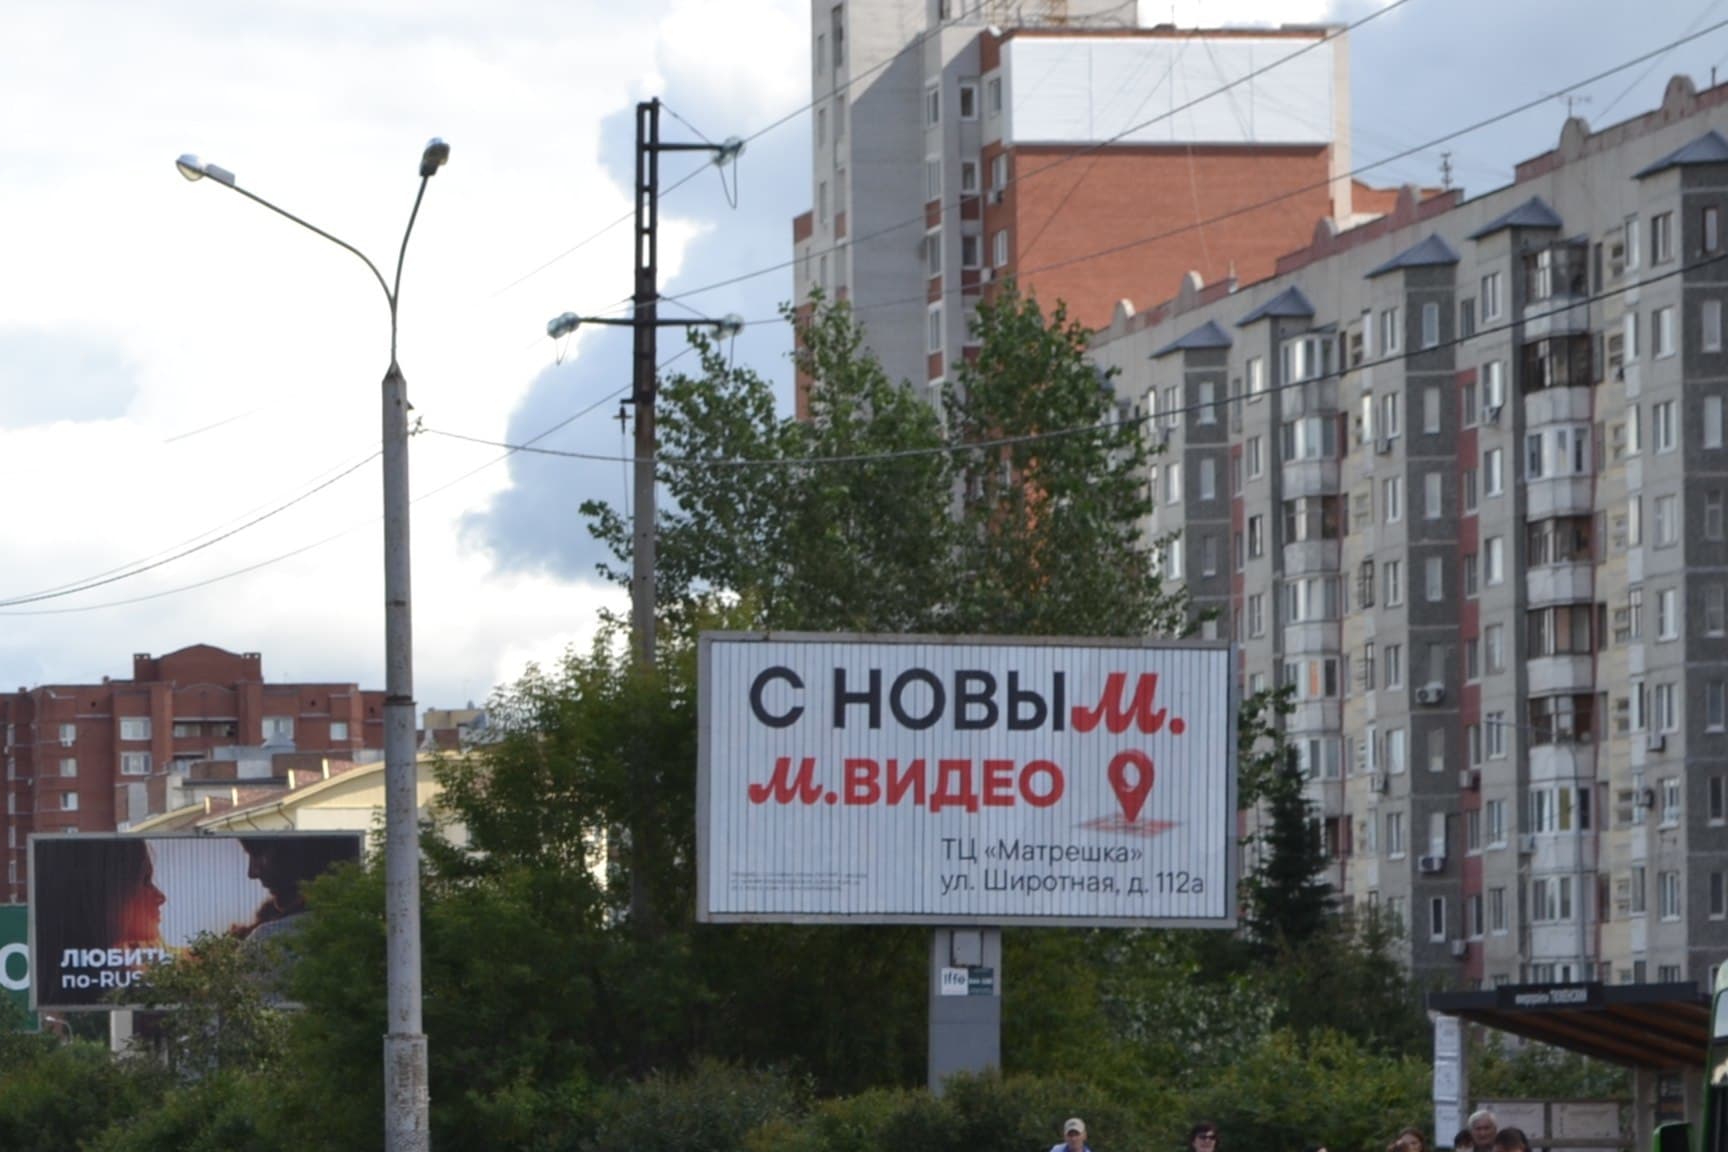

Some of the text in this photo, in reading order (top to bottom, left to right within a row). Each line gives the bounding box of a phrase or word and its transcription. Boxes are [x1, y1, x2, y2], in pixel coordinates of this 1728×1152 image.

[748, 665, 806, 729] С
[747, 756, 1065, 814] М.ВИДЕО
[941, 837, 1144, 866] ТЦ «Матрешка»
[940, 869, 1205, 896] ул. Широтная, д. 112а
